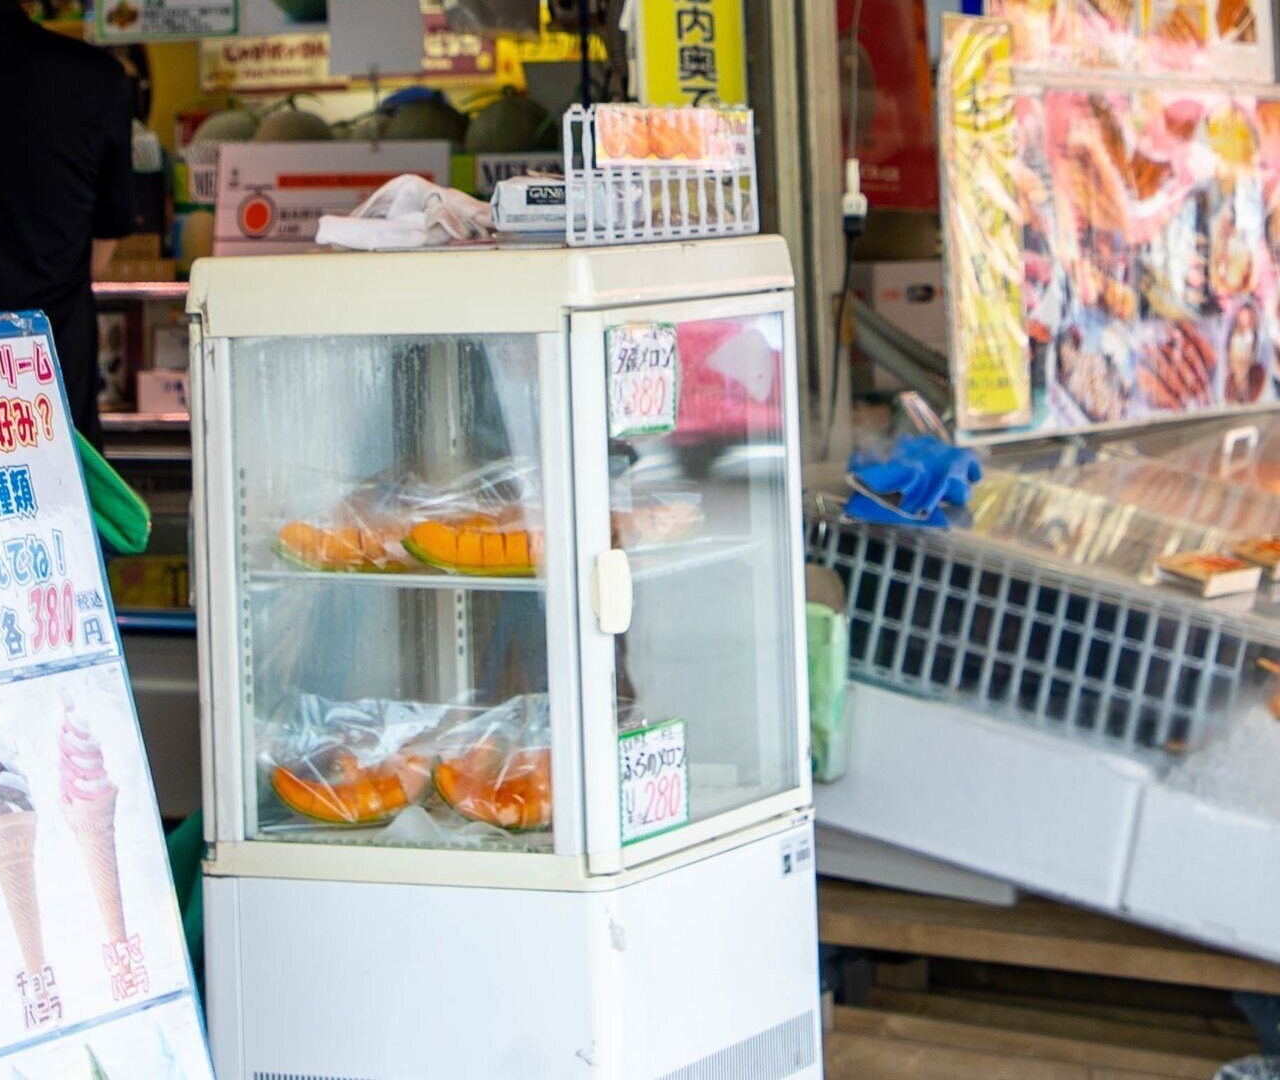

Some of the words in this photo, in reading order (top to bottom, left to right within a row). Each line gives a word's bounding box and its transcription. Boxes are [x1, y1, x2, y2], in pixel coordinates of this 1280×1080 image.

[28, 580, 76, 654] 380
[15, 965, 57, 998] チョコ
[22, 995, 65, 1028] バニラ
